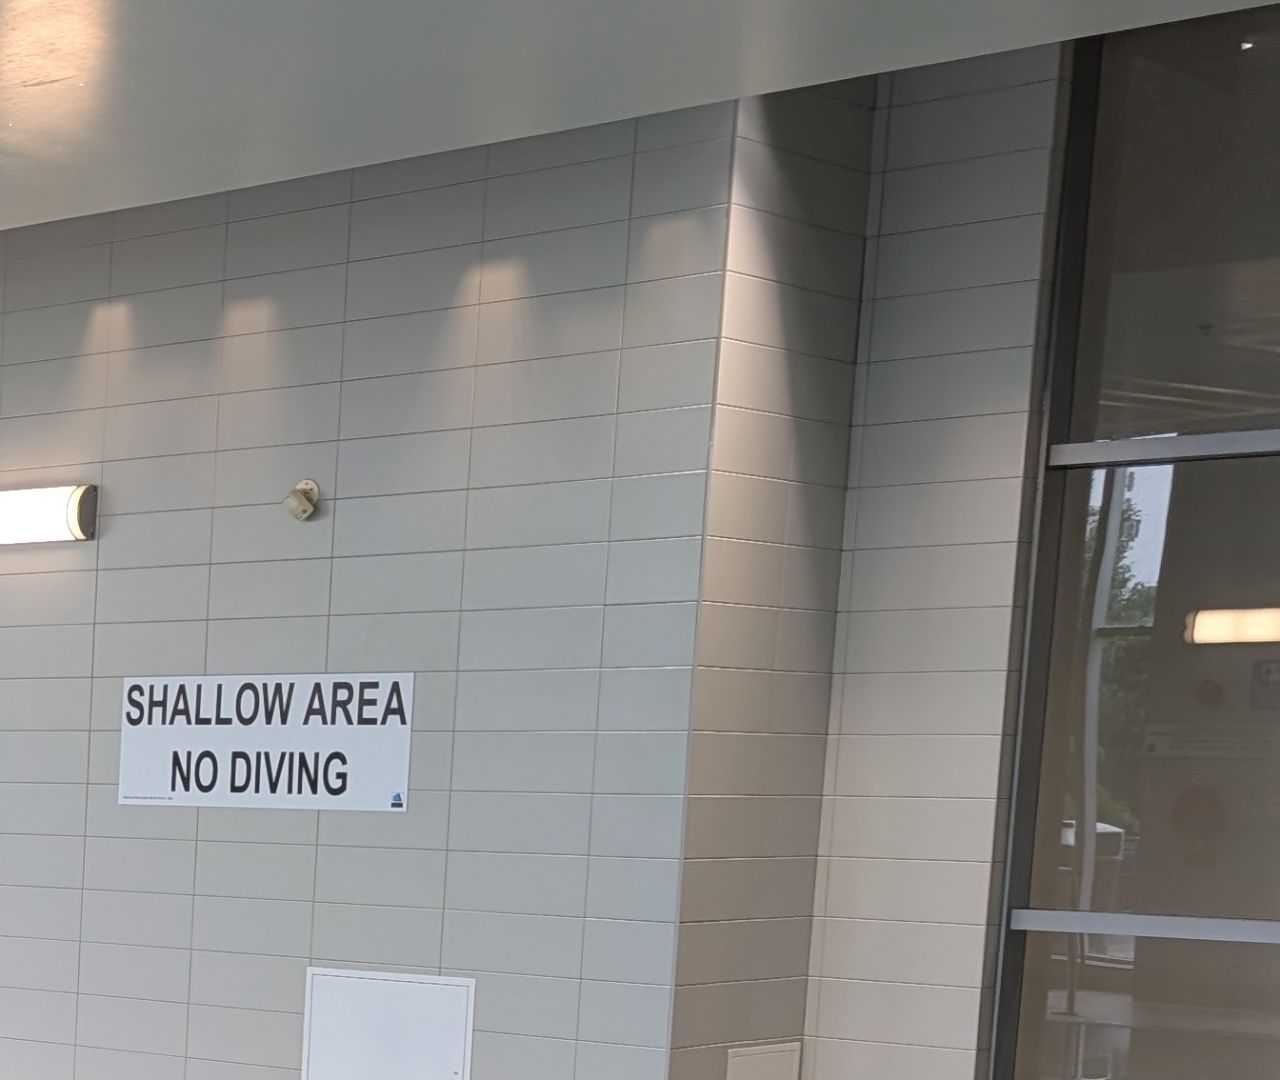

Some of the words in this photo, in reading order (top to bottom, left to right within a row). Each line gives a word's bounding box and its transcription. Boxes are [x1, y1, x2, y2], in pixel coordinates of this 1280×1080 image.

[125, 682, 295, 727] SHALLOW
[302, 680, 408, 726] AREA
[170, 749, 218, 794] NO
[229, 750, 349, 796] DIVING
